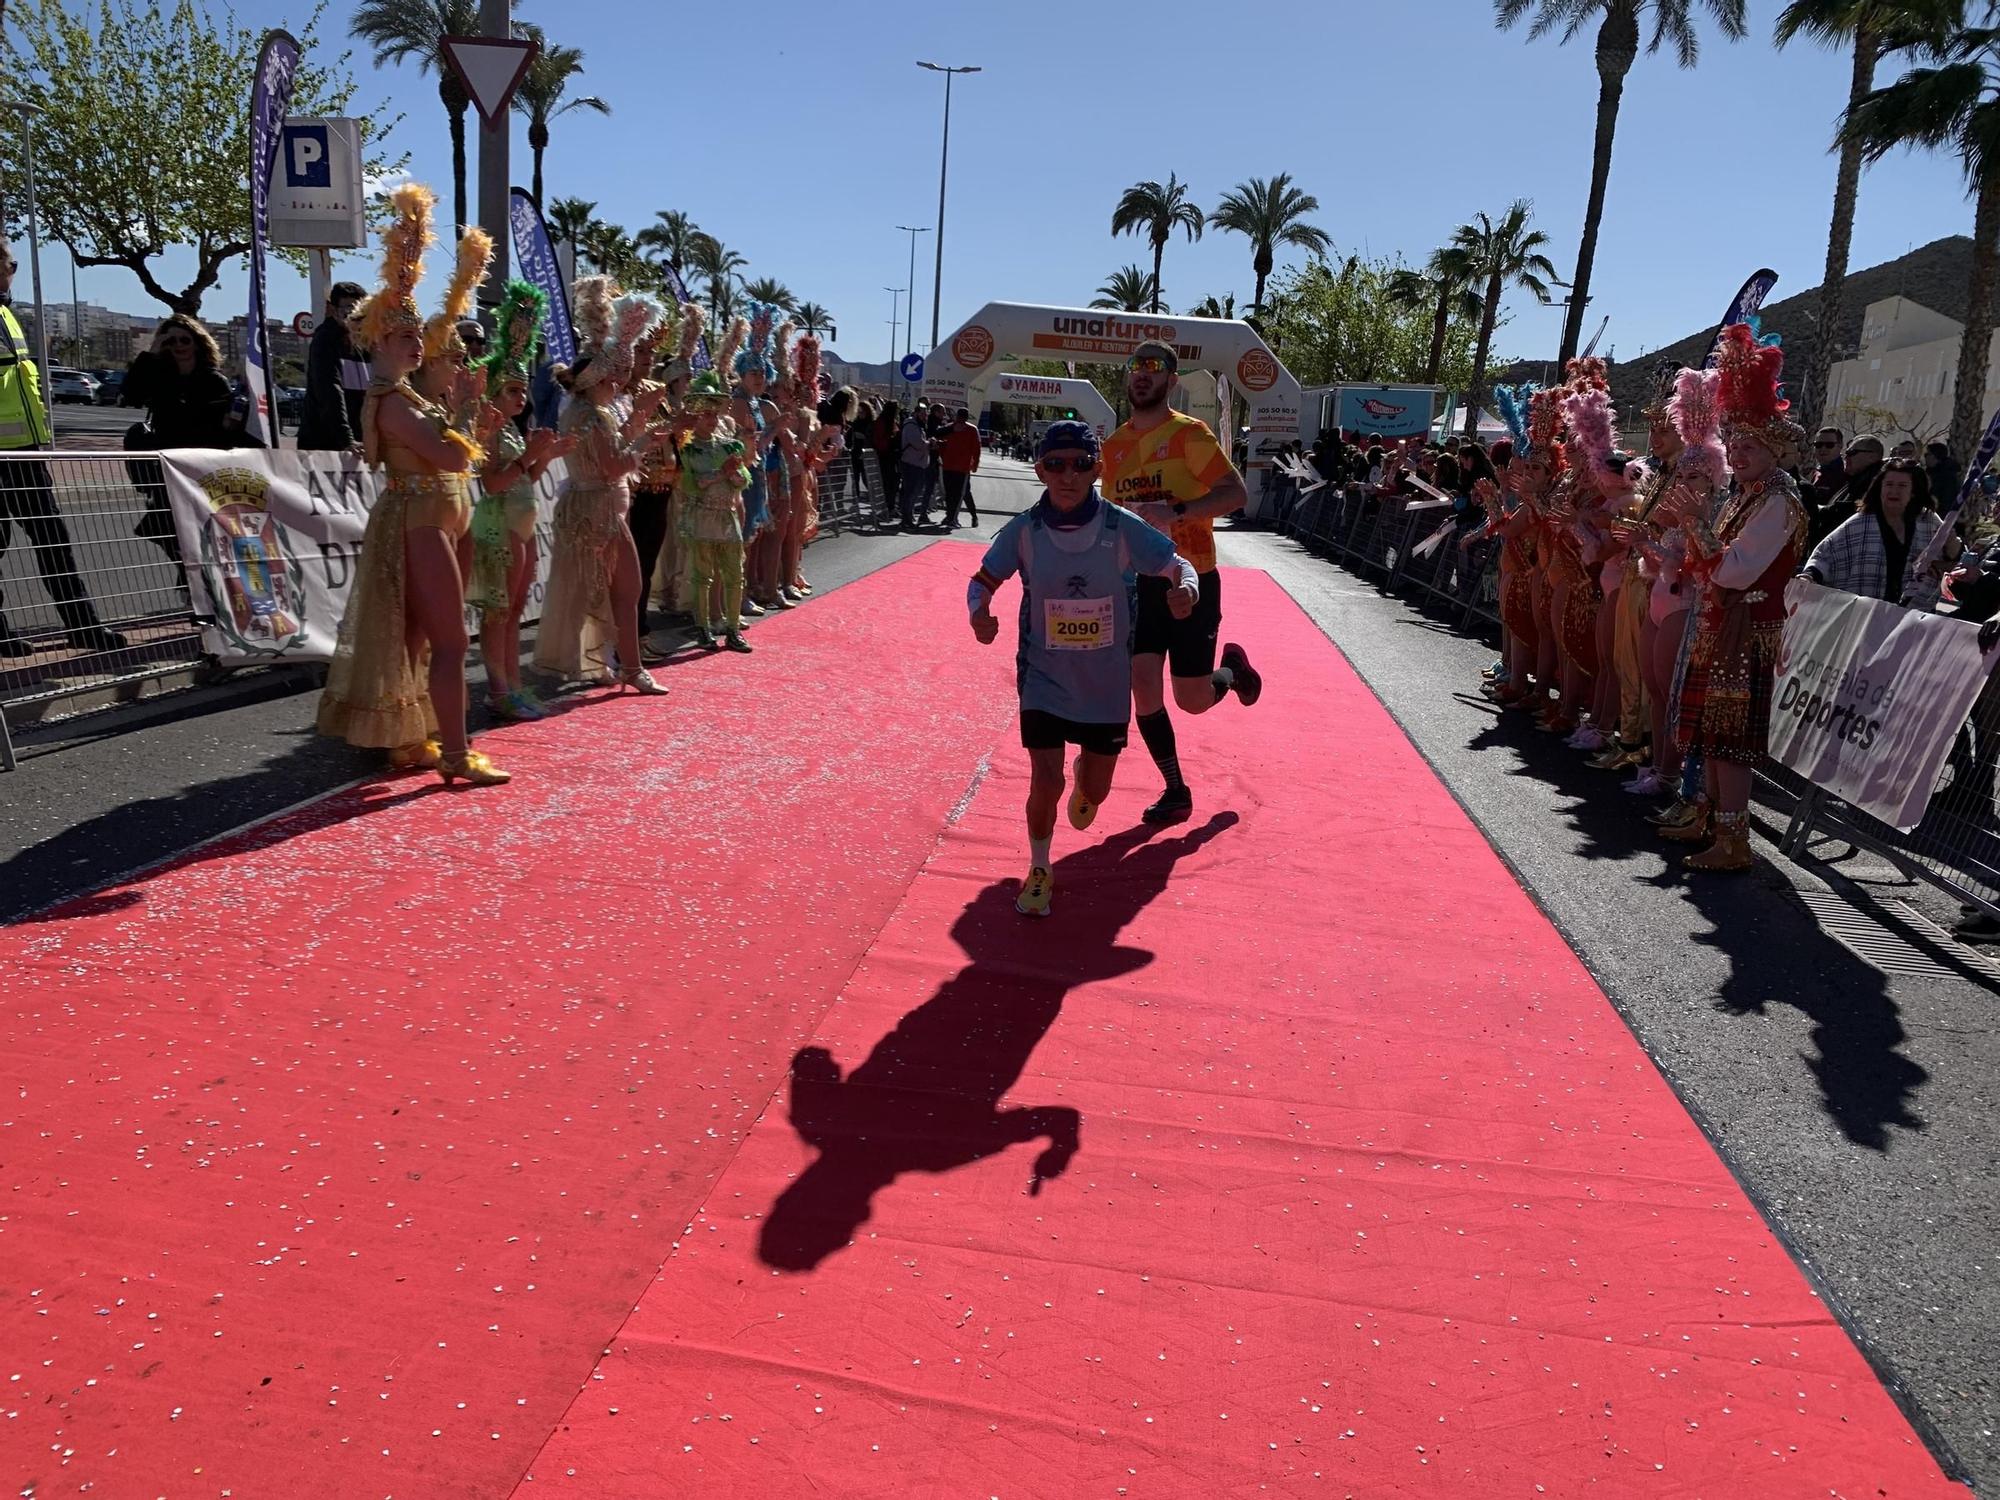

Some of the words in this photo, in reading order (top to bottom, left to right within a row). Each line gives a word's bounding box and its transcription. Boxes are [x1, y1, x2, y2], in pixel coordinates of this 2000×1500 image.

[293, 137, 322, 176] P
[301, 320, 314, 330] 20
[1062, 338, 1093, 350] ALQUILER
[1015, 379, 1062, 394] YAMAHA
[1057, 621, 1100, 635] 2090
[1777, 675, 1881, 751] Deportes
